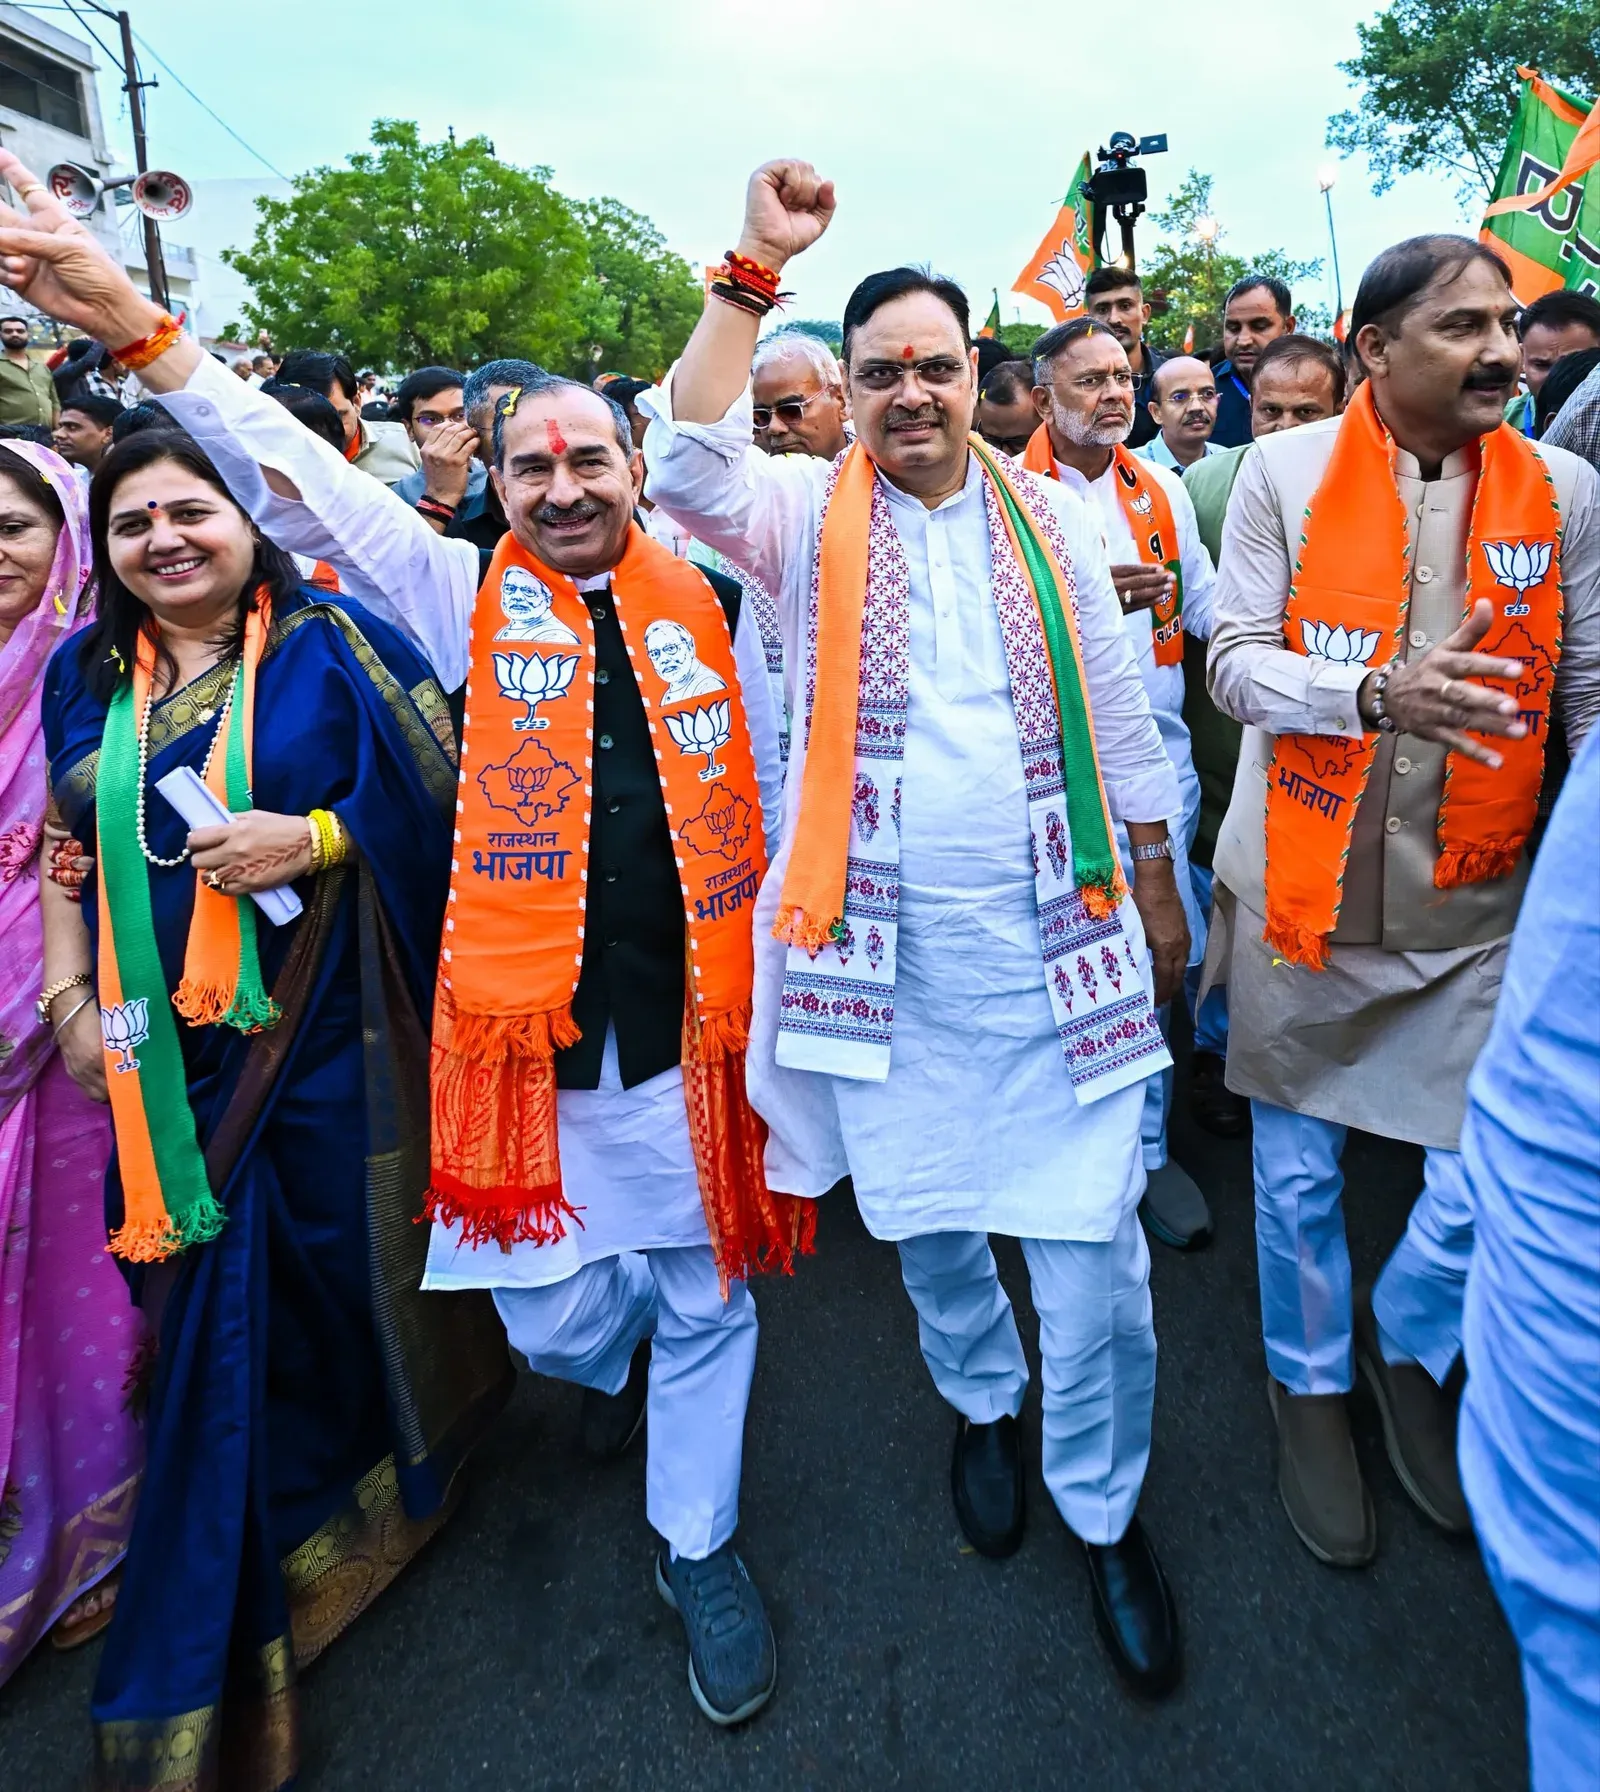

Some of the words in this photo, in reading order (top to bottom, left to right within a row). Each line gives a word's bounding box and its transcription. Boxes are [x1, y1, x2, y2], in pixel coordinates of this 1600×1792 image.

[1279, 767, 1347, 821] भाजपा
[488, 832, 559, 848] राजस्थान
[473, 850, 572, 881] भाजपा
[704, 858, 753, 892] राजस्थान
[695, 870, 759, 922] भाजपा
